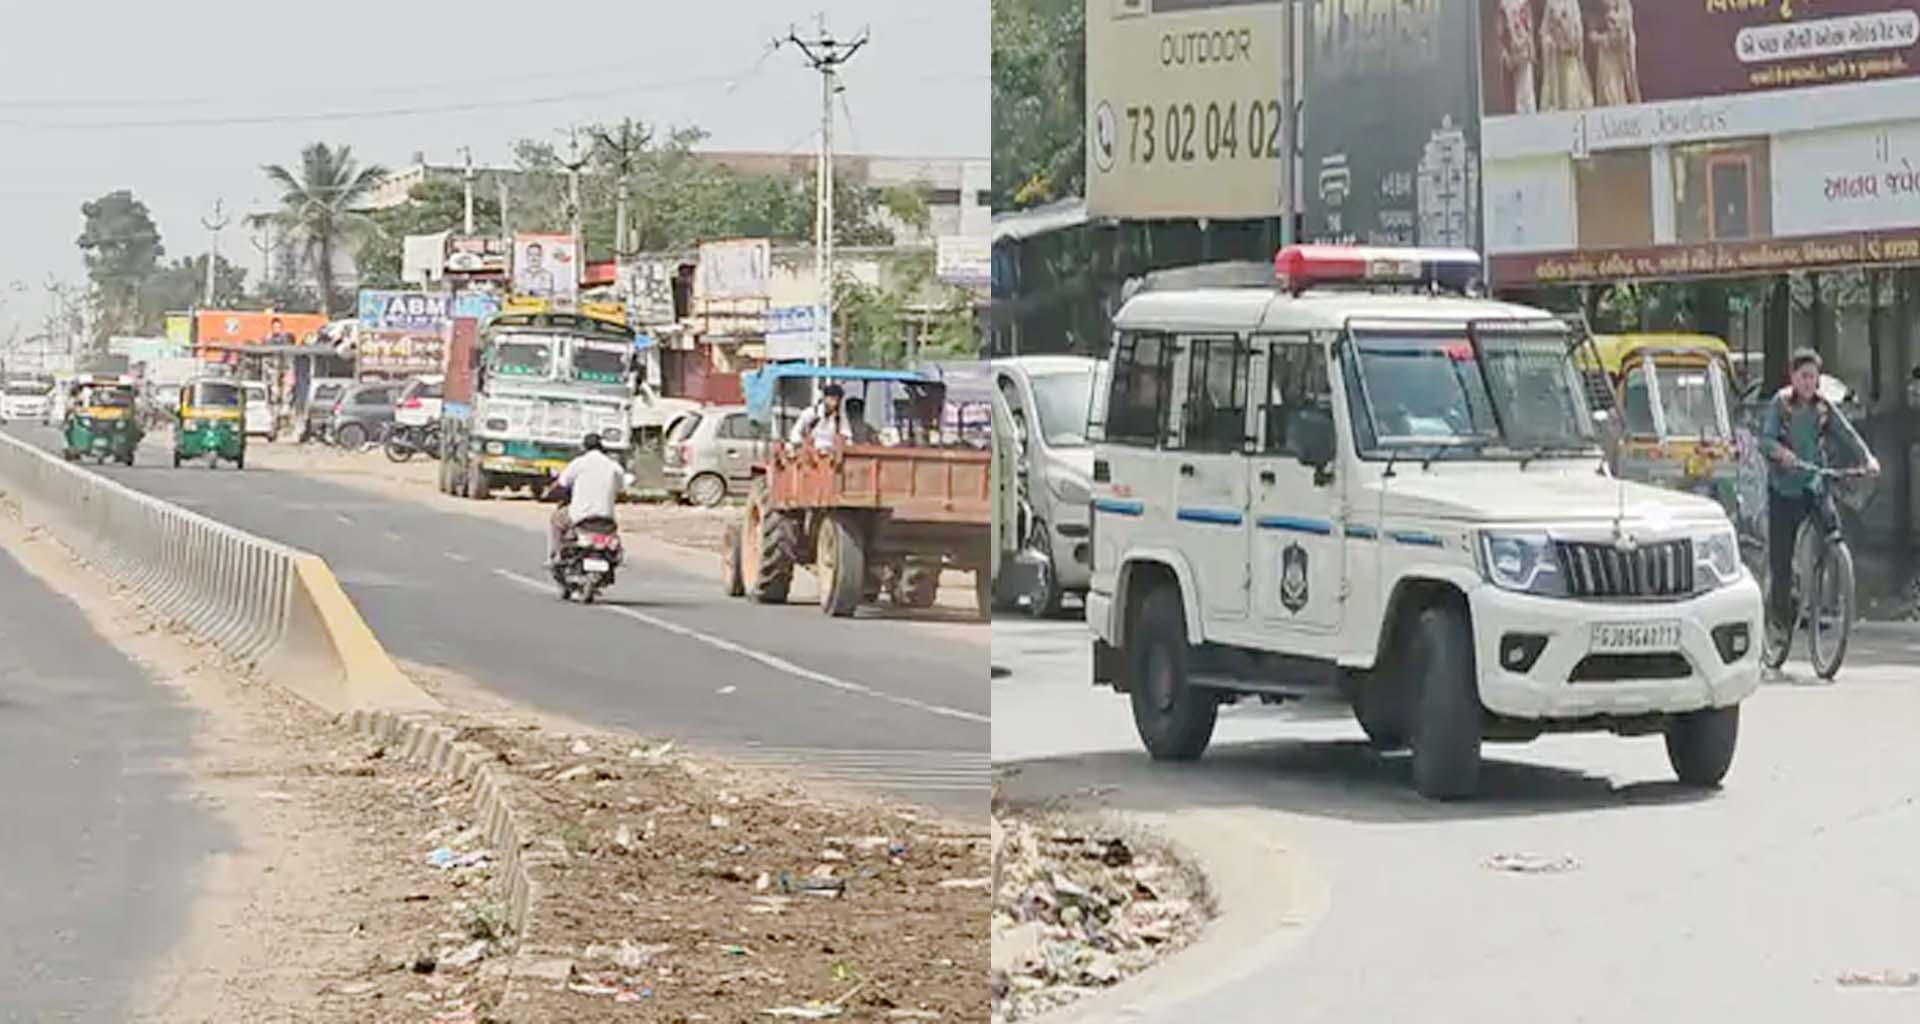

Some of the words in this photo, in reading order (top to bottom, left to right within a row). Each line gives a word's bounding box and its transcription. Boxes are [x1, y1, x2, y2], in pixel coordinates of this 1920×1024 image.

[1161, 29, 1251, 66] OUTDOOR
[1126, 104, 1156, 164] 73
[1165, 102, 1195, 163] 02
[1205, 100, 1237, 162] 04
[1249, 99, 1282, 159] 02
[388, 297, 446, 316] ABM
